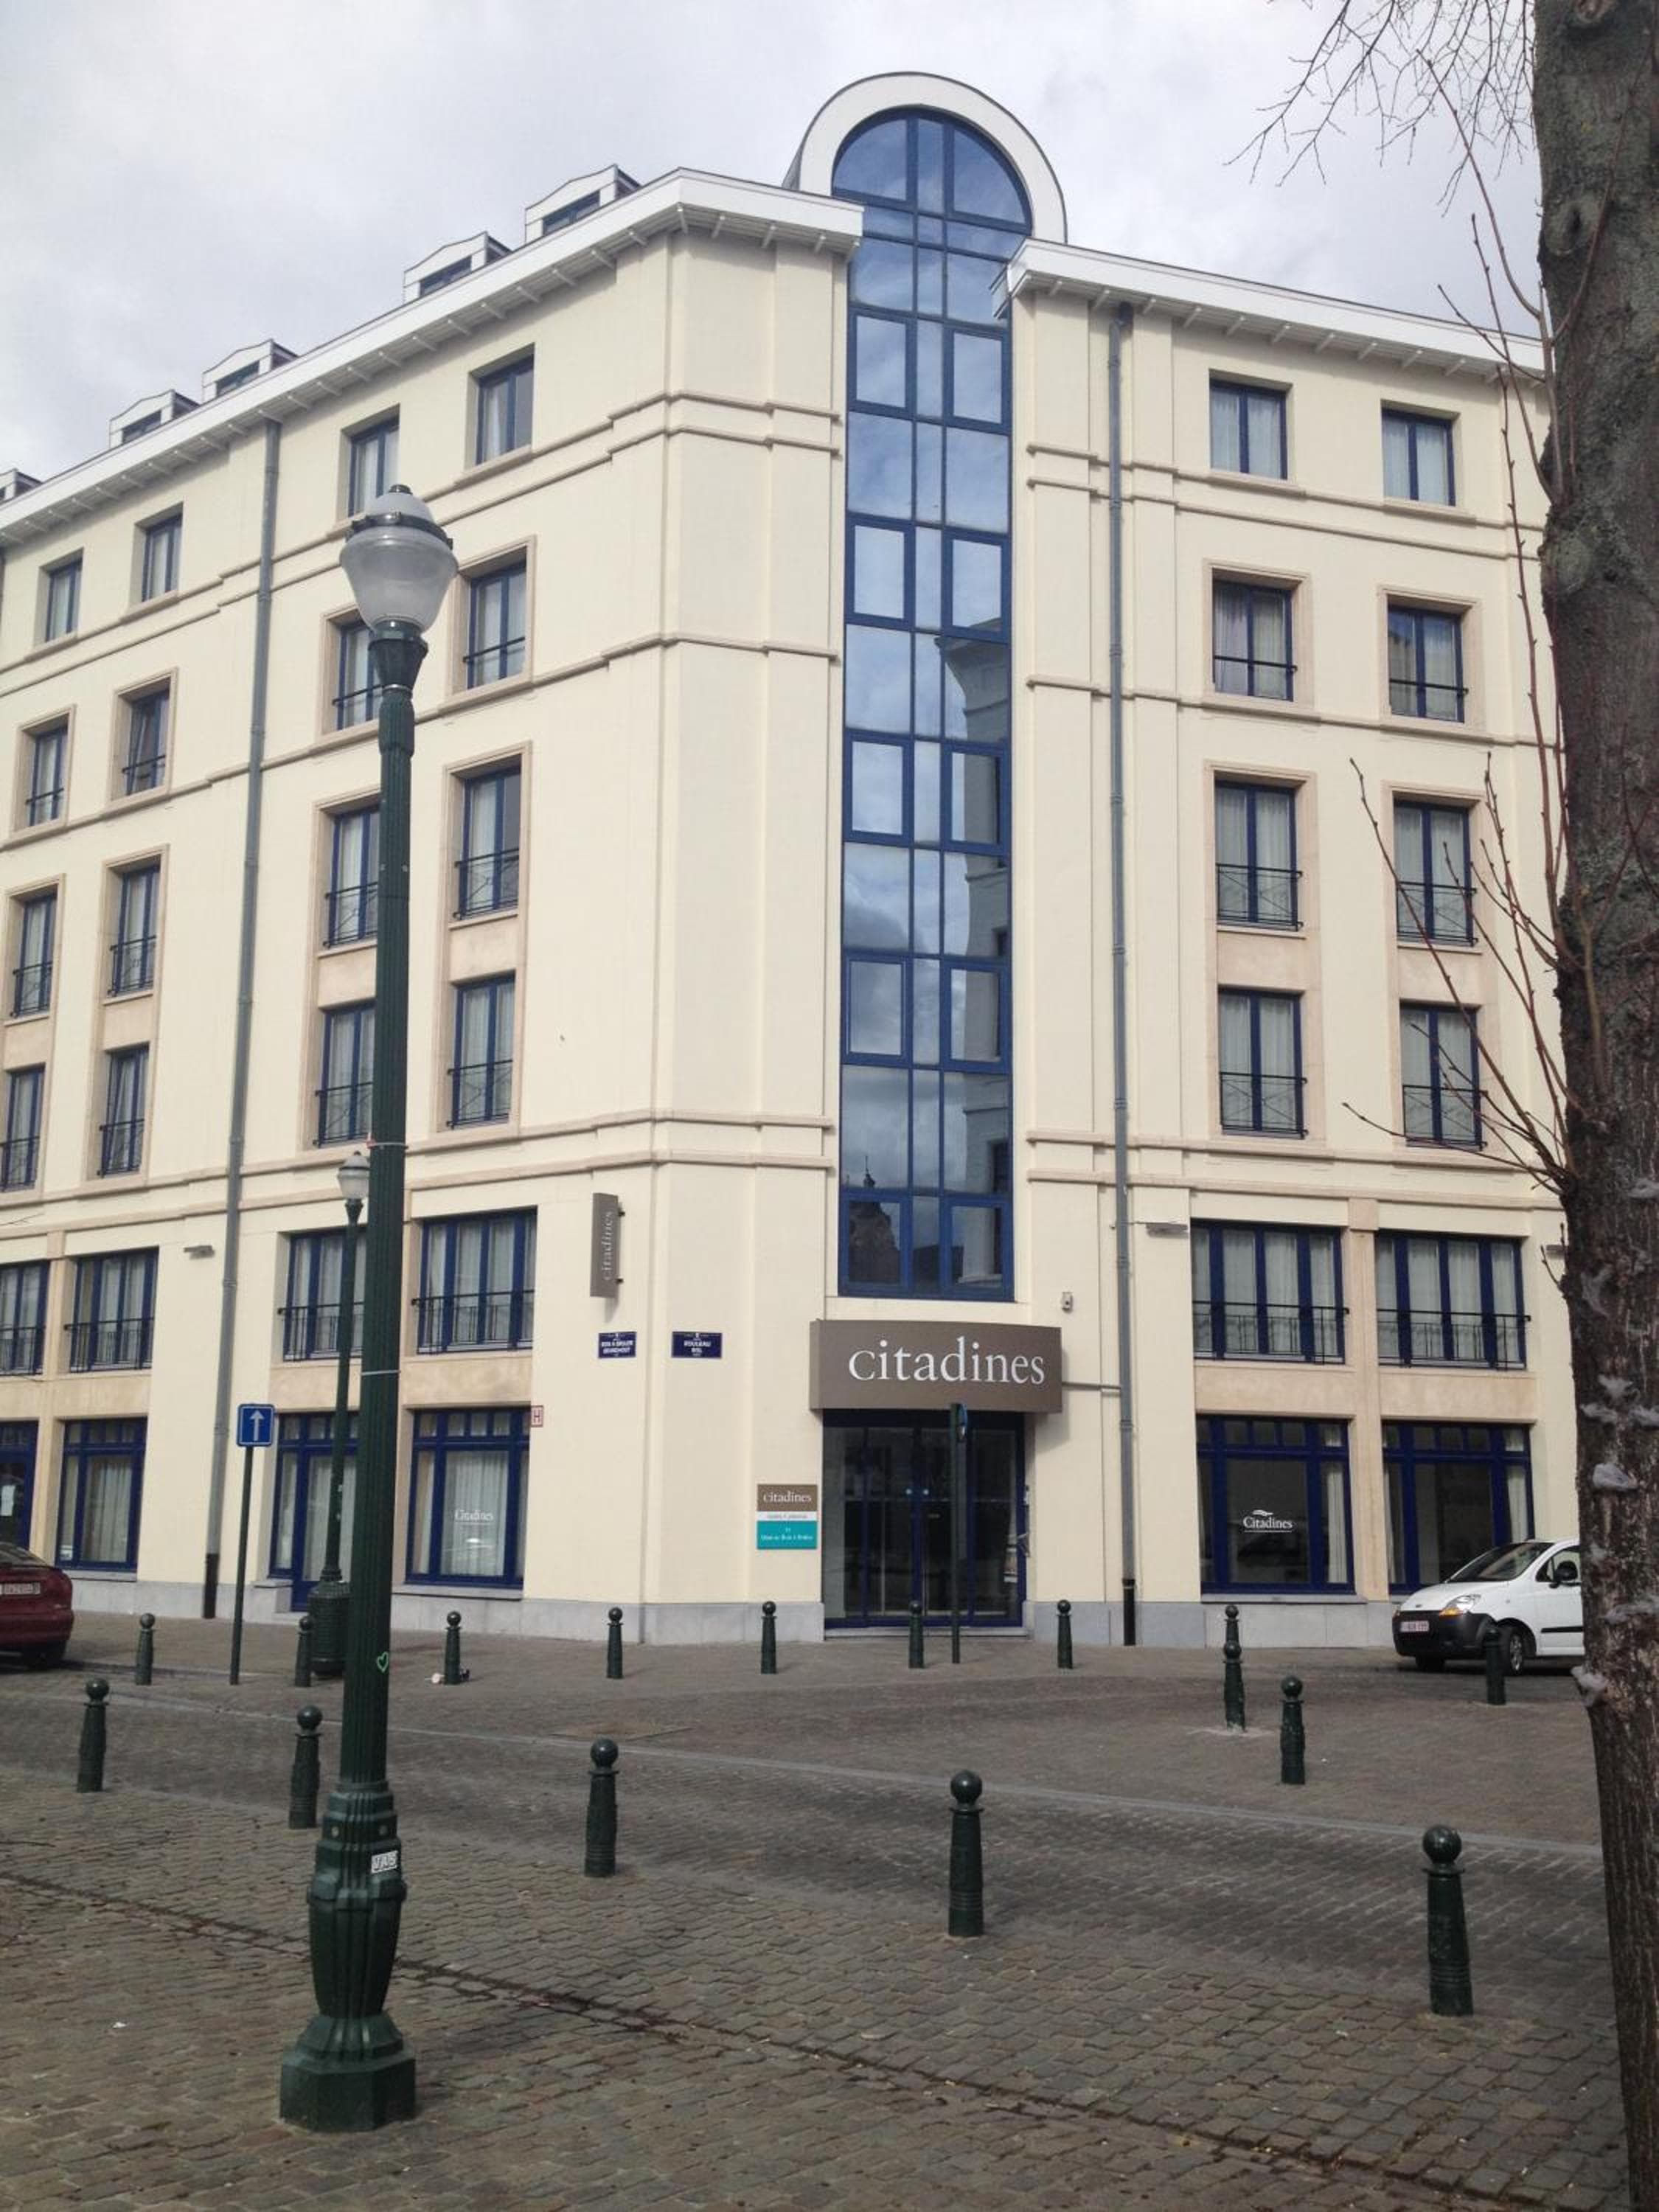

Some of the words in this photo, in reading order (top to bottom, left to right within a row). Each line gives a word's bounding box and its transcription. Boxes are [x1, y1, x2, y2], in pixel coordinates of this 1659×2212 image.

[602, 1211, 613, 1281] citadines
[848, 1336, 1045, 1385] citadines
[762, 1489, 812, 1503] citadines
[1242, 1515, 1293, 1528] Citadines
